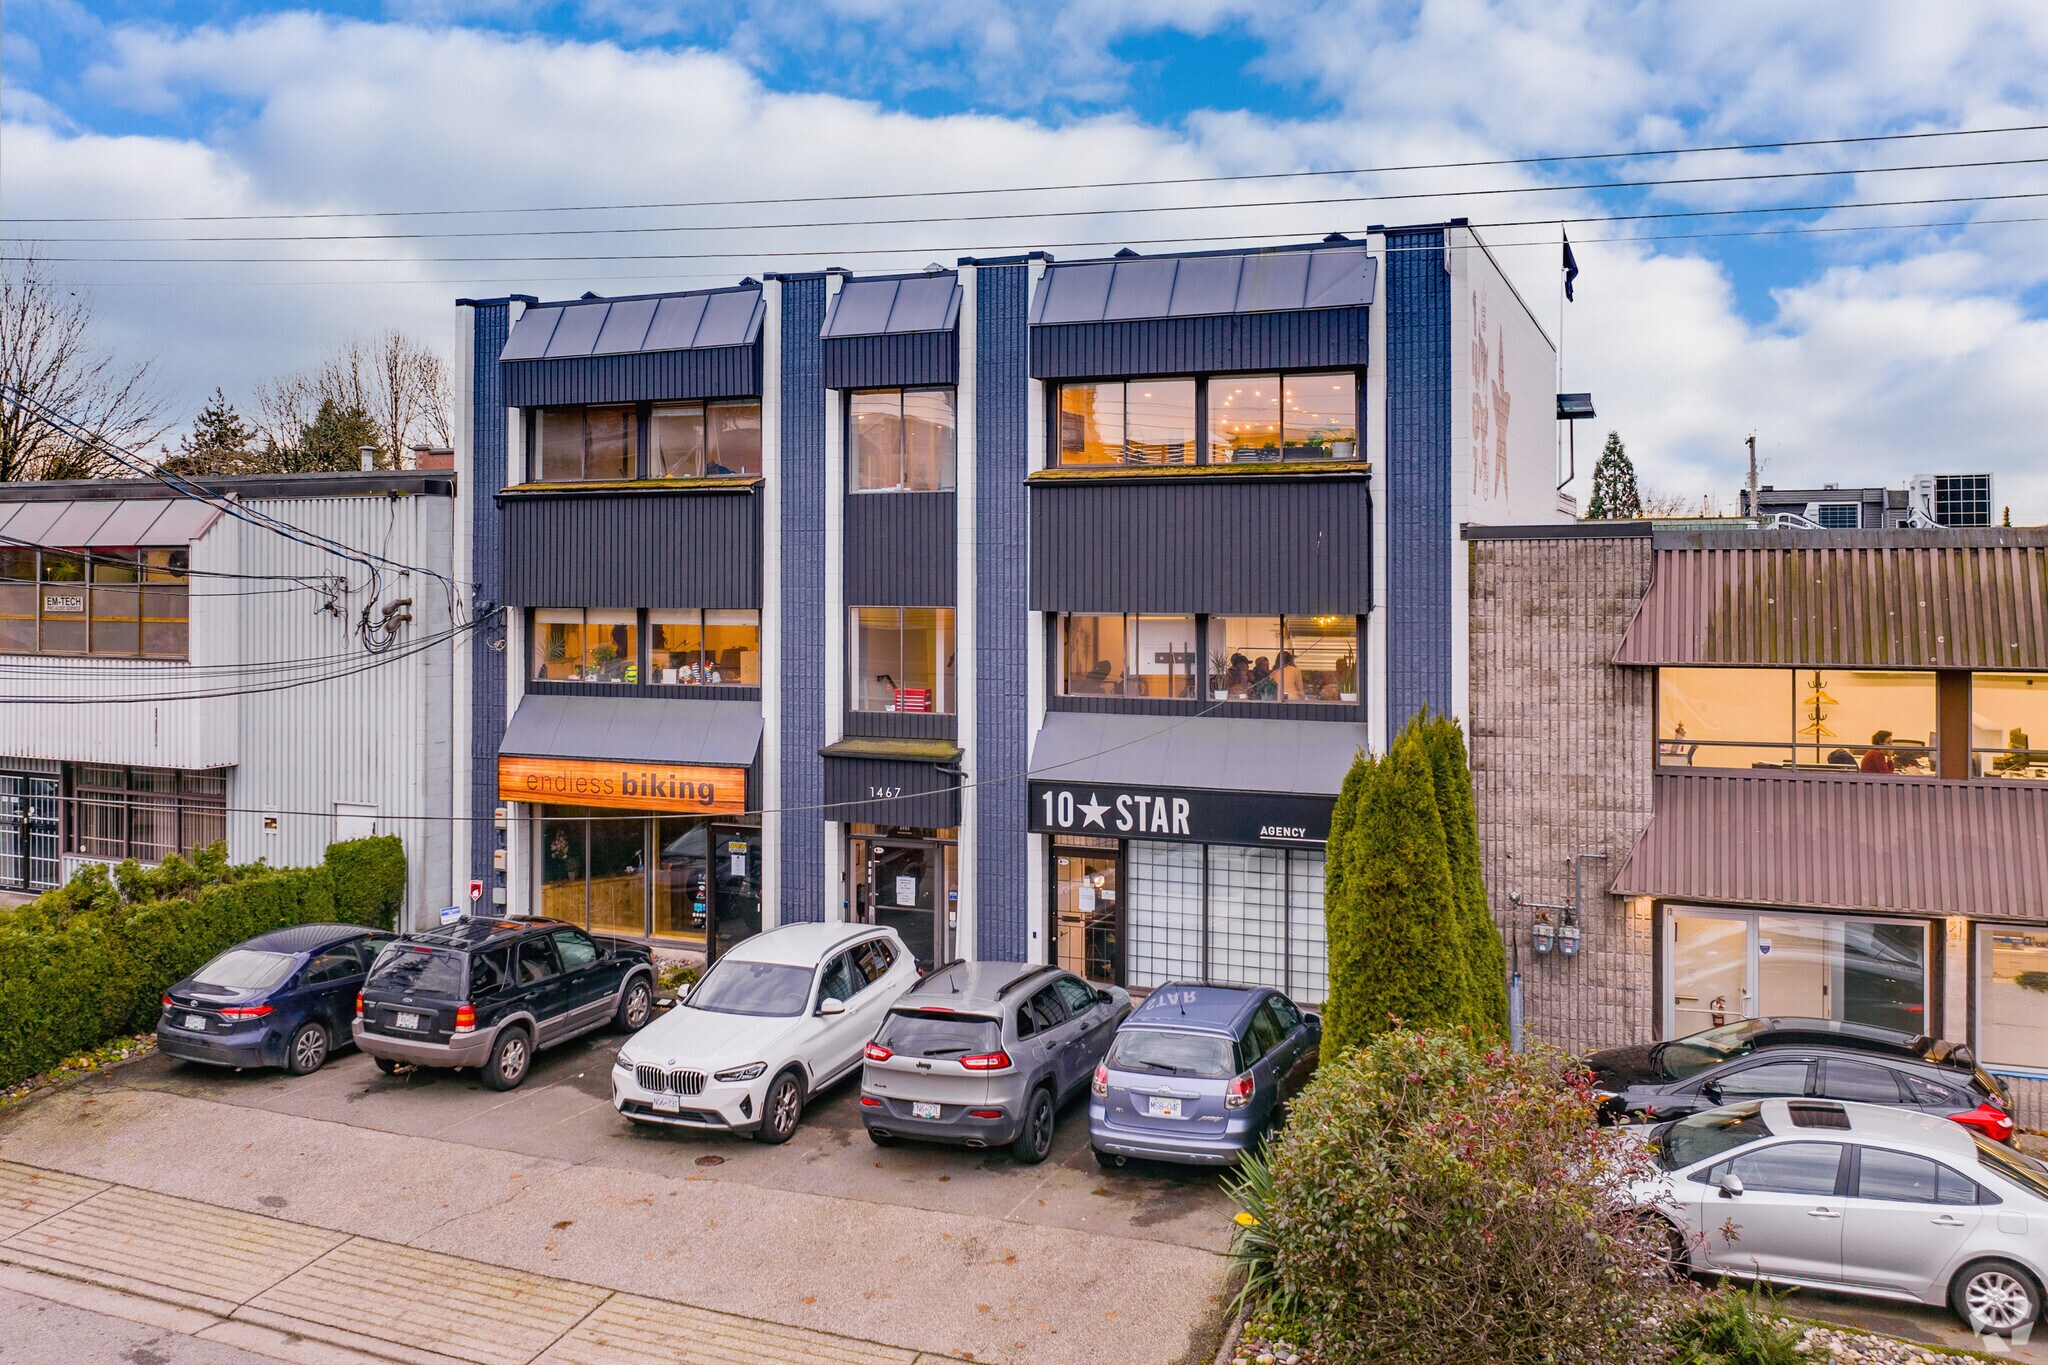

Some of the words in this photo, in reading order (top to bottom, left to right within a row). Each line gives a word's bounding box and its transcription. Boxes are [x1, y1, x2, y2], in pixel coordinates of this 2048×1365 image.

[47, 597, 81, 606] EM-TECH
[527, 770, 614, 795] endless
[622, 772, 714, 806] biking
[870, 786, 901, 798] 1467
[1042, 791, 1074, 828] 10
[1116, 794, 1191, 835] STAR
[1260, 826, 1306, 838] AGENCY
